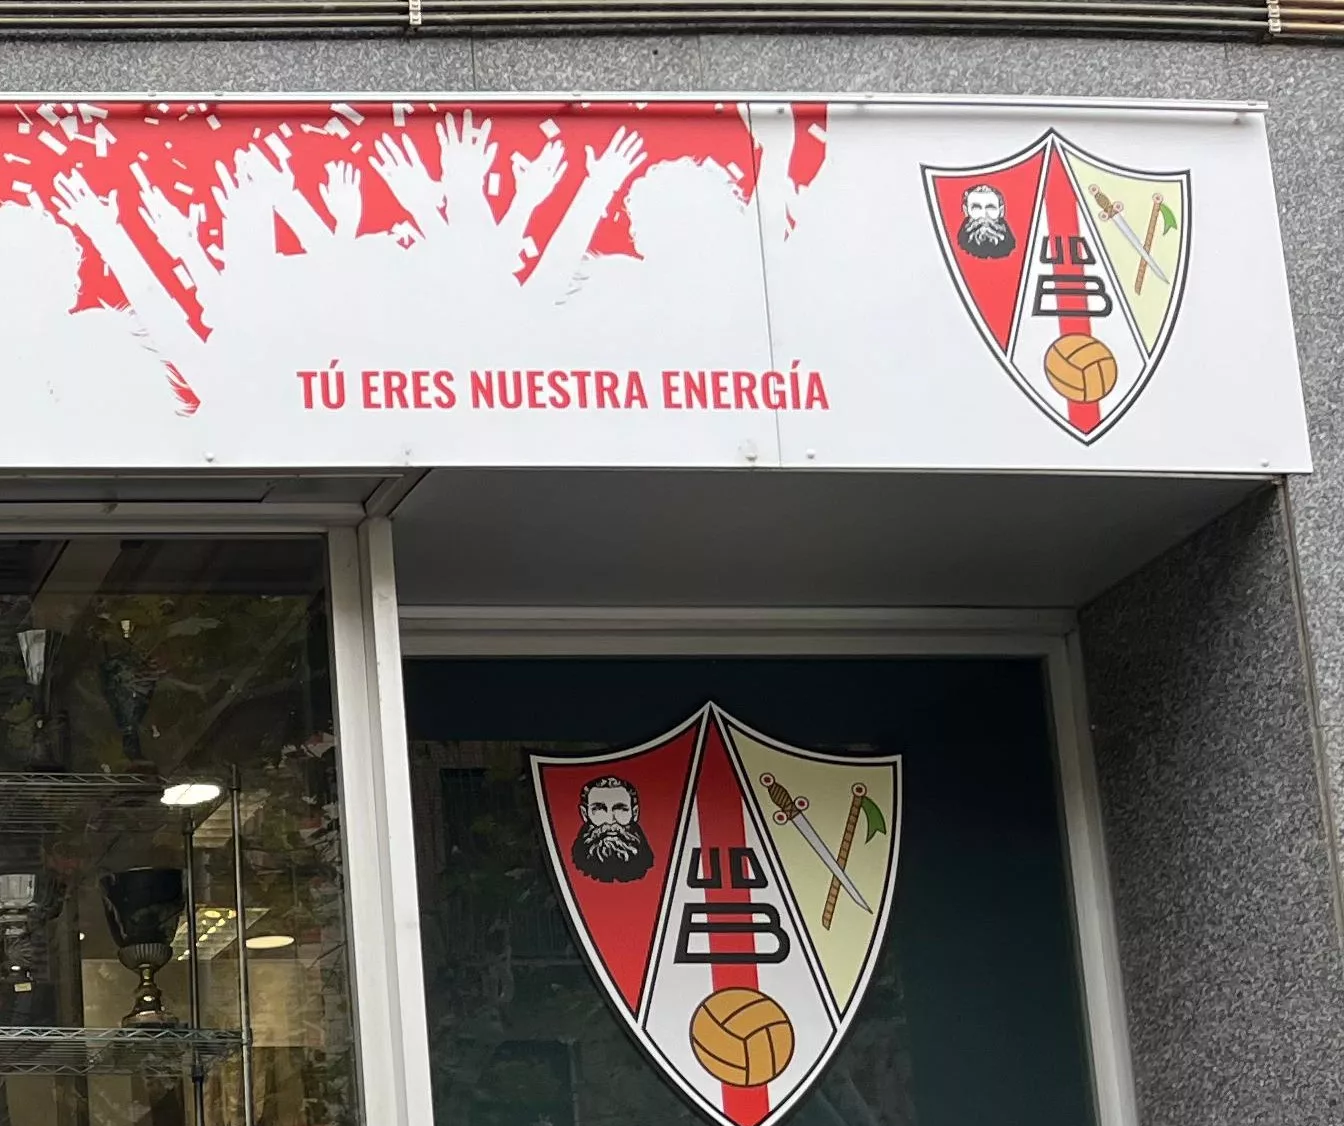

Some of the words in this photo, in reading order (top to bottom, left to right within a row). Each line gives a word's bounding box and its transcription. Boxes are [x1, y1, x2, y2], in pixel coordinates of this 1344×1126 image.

[296, 359, 346, 410] TÚ
[361, 370, 456, 410] ERES
[470, 370, 649, 410] NUESTRA
[662, 359, 830, 411] ENERGÍA
